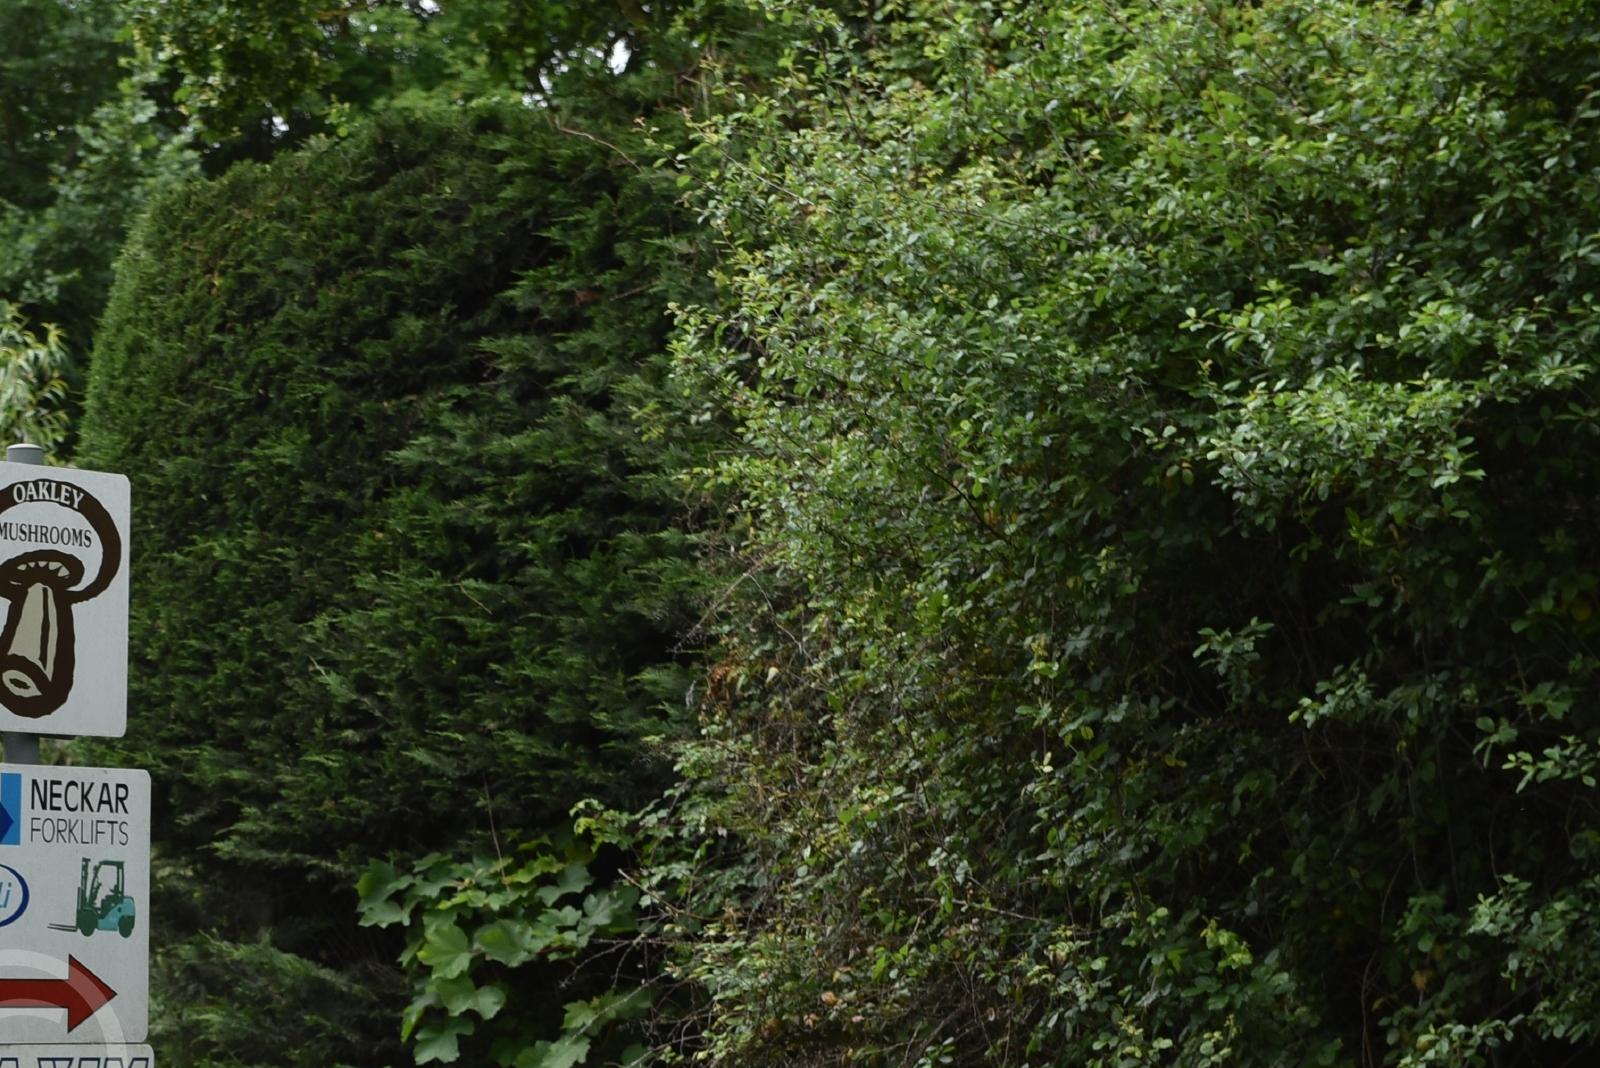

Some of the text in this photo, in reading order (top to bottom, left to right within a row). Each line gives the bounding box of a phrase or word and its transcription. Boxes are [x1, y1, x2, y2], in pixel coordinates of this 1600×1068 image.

[12, 480, 85, 511] OAKLEY
[30, 778, 129, 815] NECKAR
[30, 816, 129, 847] FORKLIFTS
